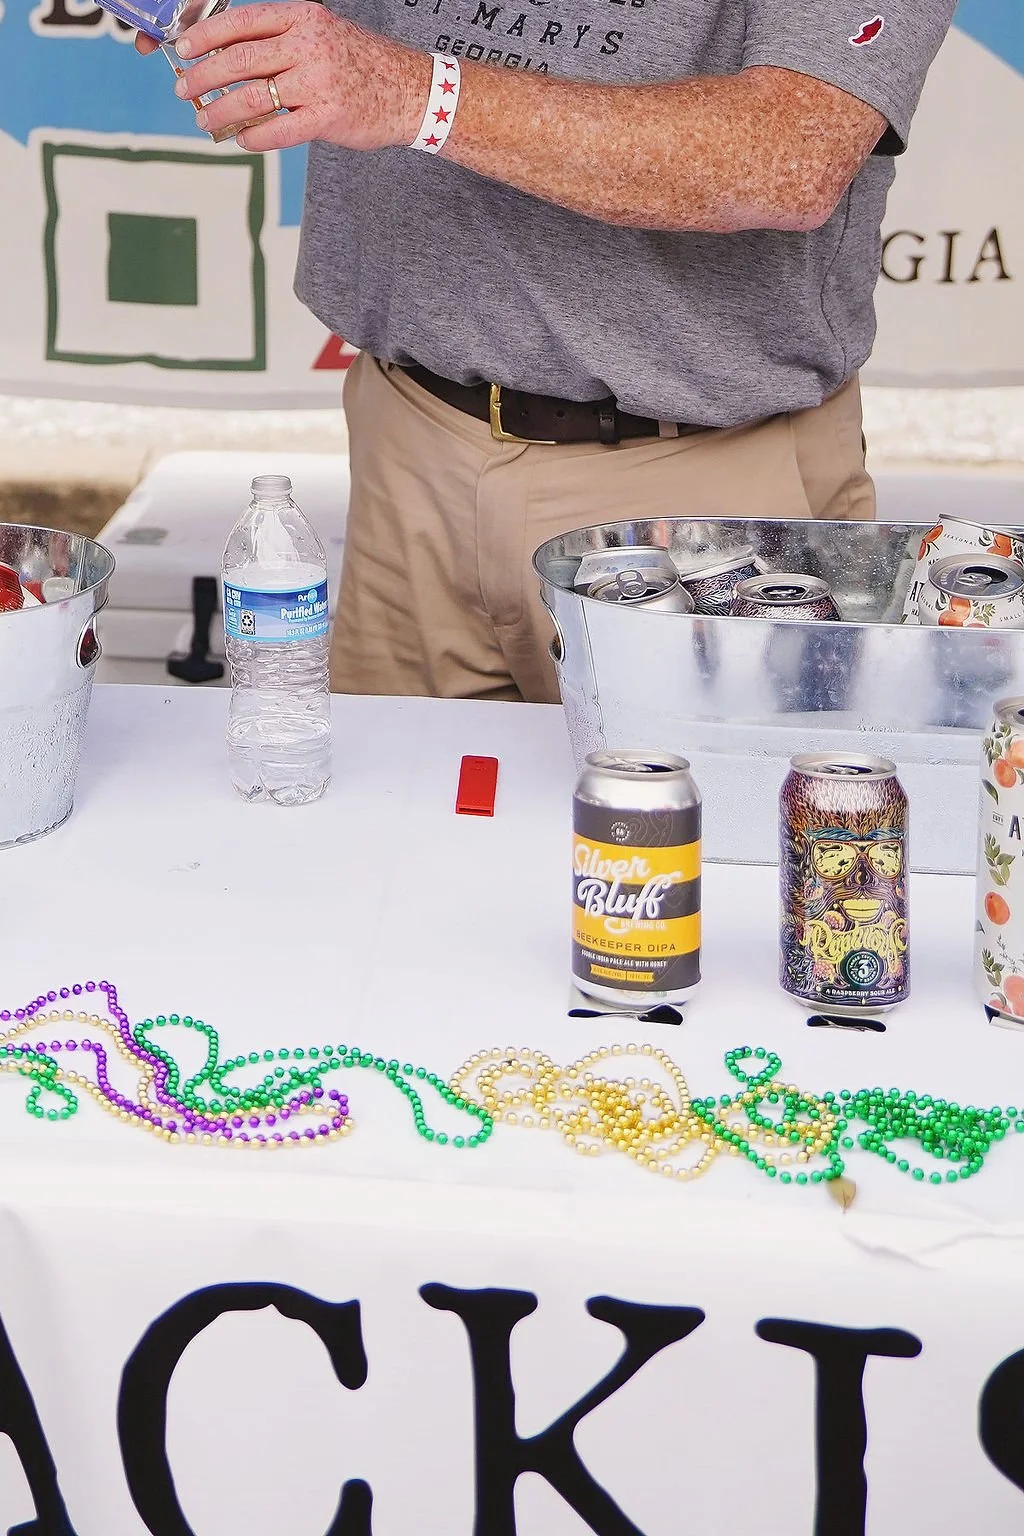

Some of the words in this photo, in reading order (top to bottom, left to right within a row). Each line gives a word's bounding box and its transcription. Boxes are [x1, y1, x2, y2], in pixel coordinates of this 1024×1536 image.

[435, 34, 549, 73] GEORGIA
[880, 226, 1013, 284] GIA
[909, 580, 925, 603] AT
[281, 603, 313, 620] Purified
[1008, 814, 1024, 841] A
[574, 843, 651, 879] Silver
[577, 870, 684, 920] Bluff
[576, 930, 642, 952] BEEKEEPER
[647, 943, 677, 952] DIPA
[858, 959, 870, 978] 3
[832, 988, 869, 997] RASPBERRY
